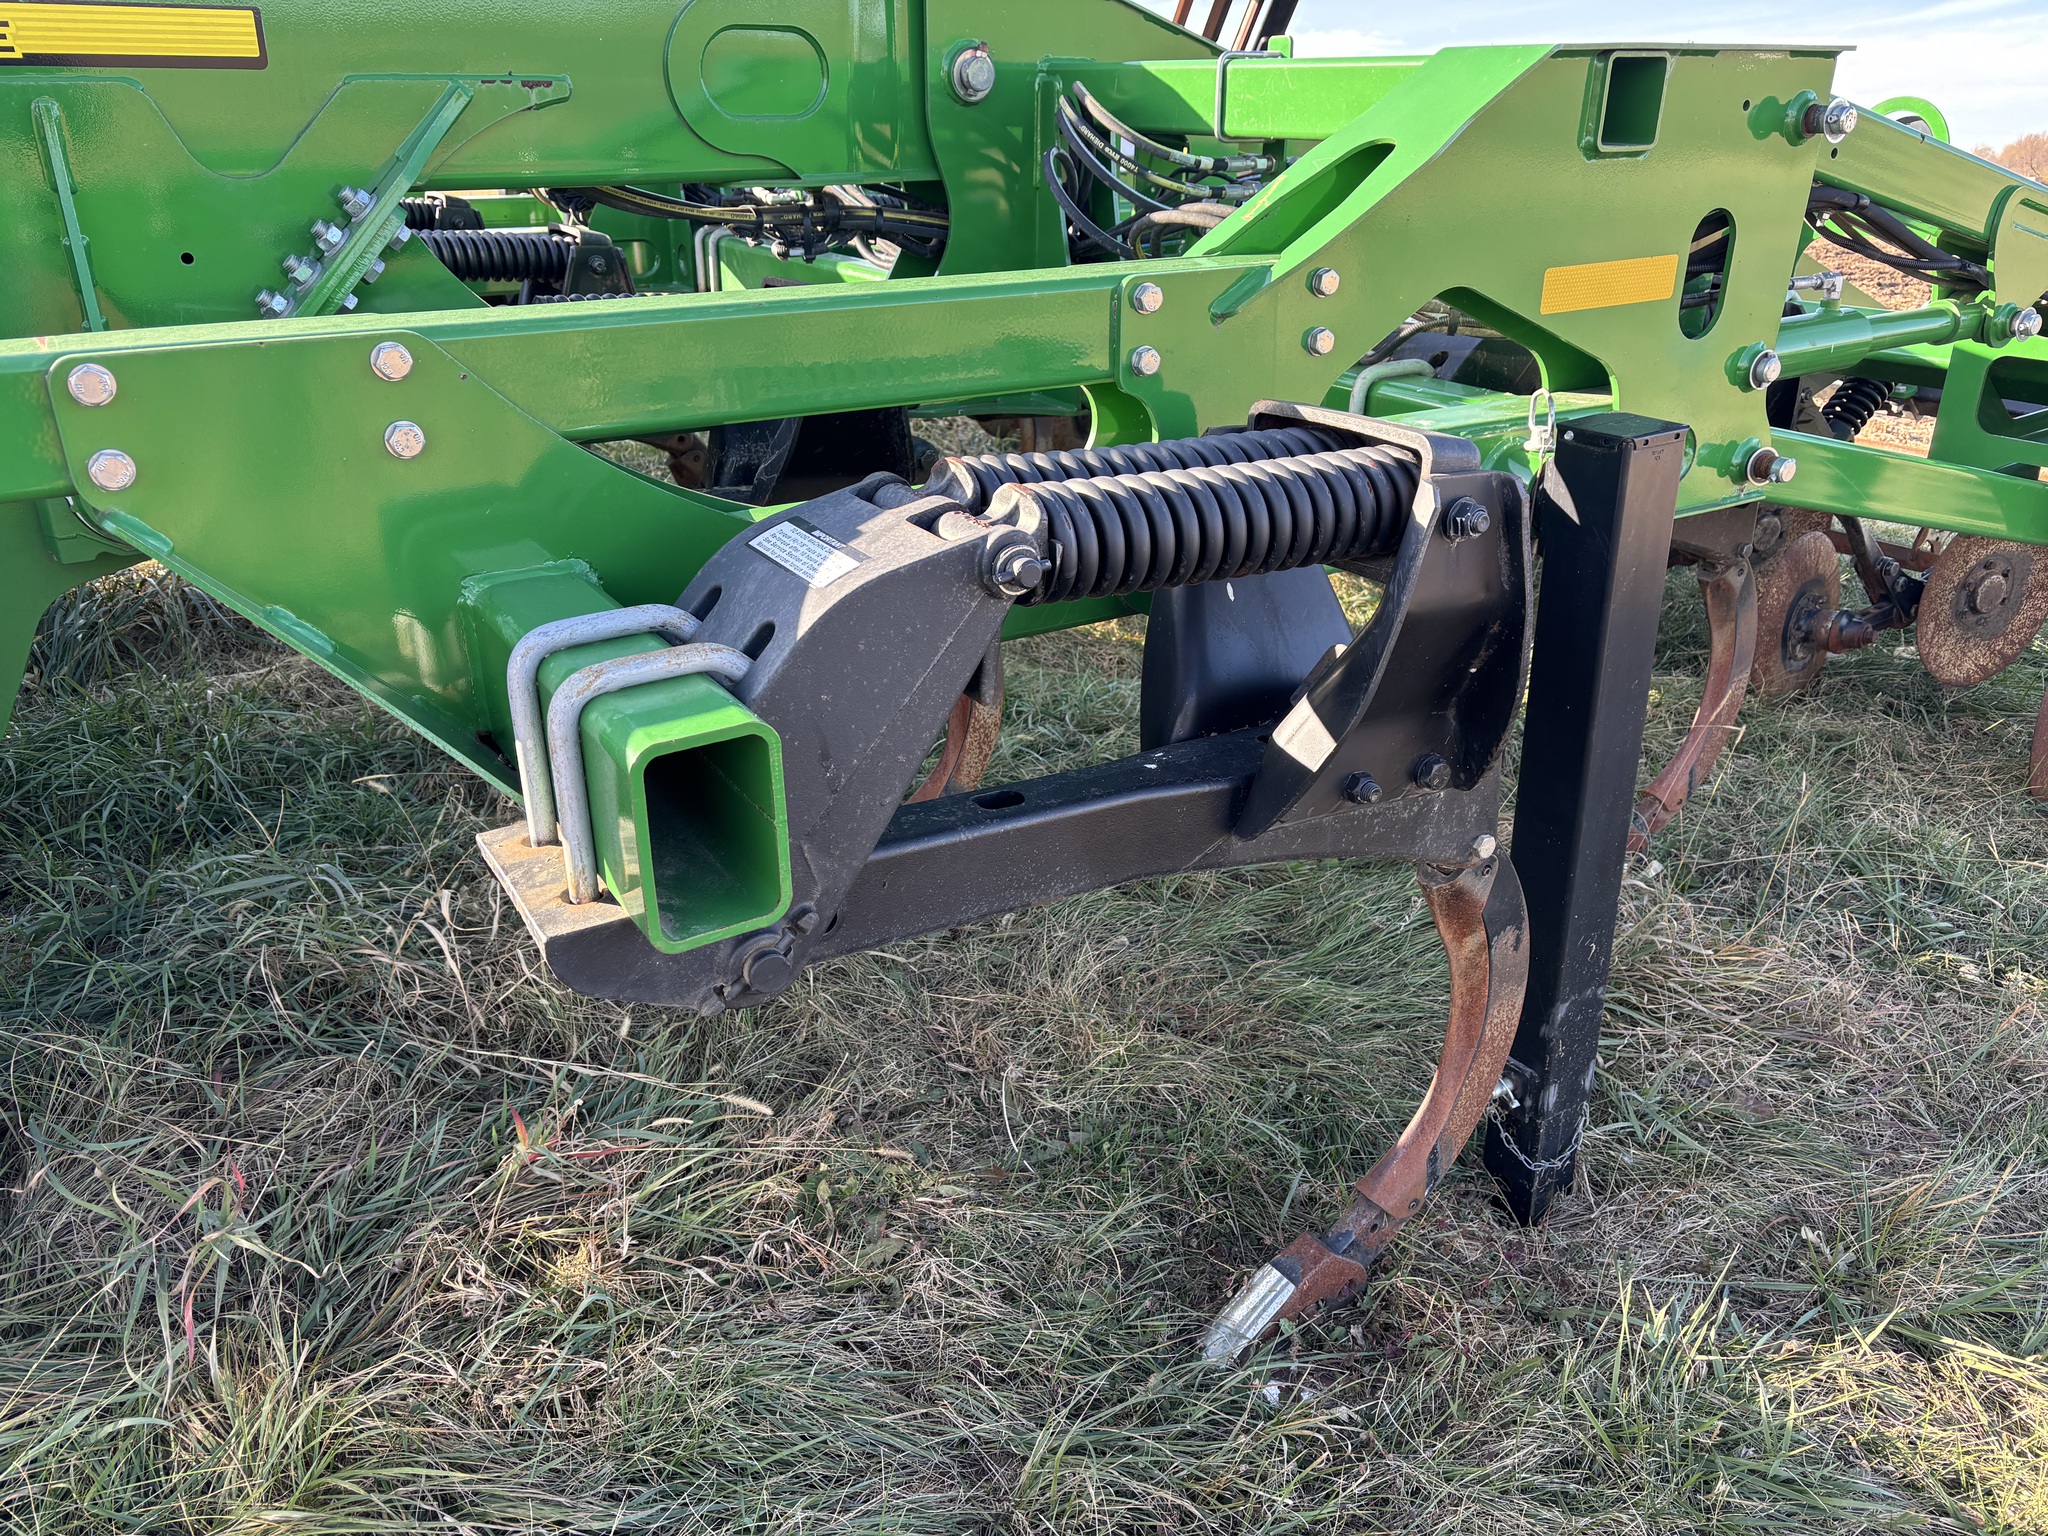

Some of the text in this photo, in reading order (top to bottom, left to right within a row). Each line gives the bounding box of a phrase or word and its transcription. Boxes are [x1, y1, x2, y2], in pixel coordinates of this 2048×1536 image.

[1079, 124, 1105, 149] DIEHARD
[1119, 158, 1139, 173] T4000
[796, 531, 810, 540] AVOID
[807, 537, 826, 552] MACHINE
[810, 529, 847, 550] IMPORTANT
[756, 541, 773, 552] Manual
[774, 553, 791, 565] proper
[788, 561, 804, 573] torque
[770, 541, 787, 554] Service
[785, 550, 803, 563] Section
[804, 554, 819, 565] hours
